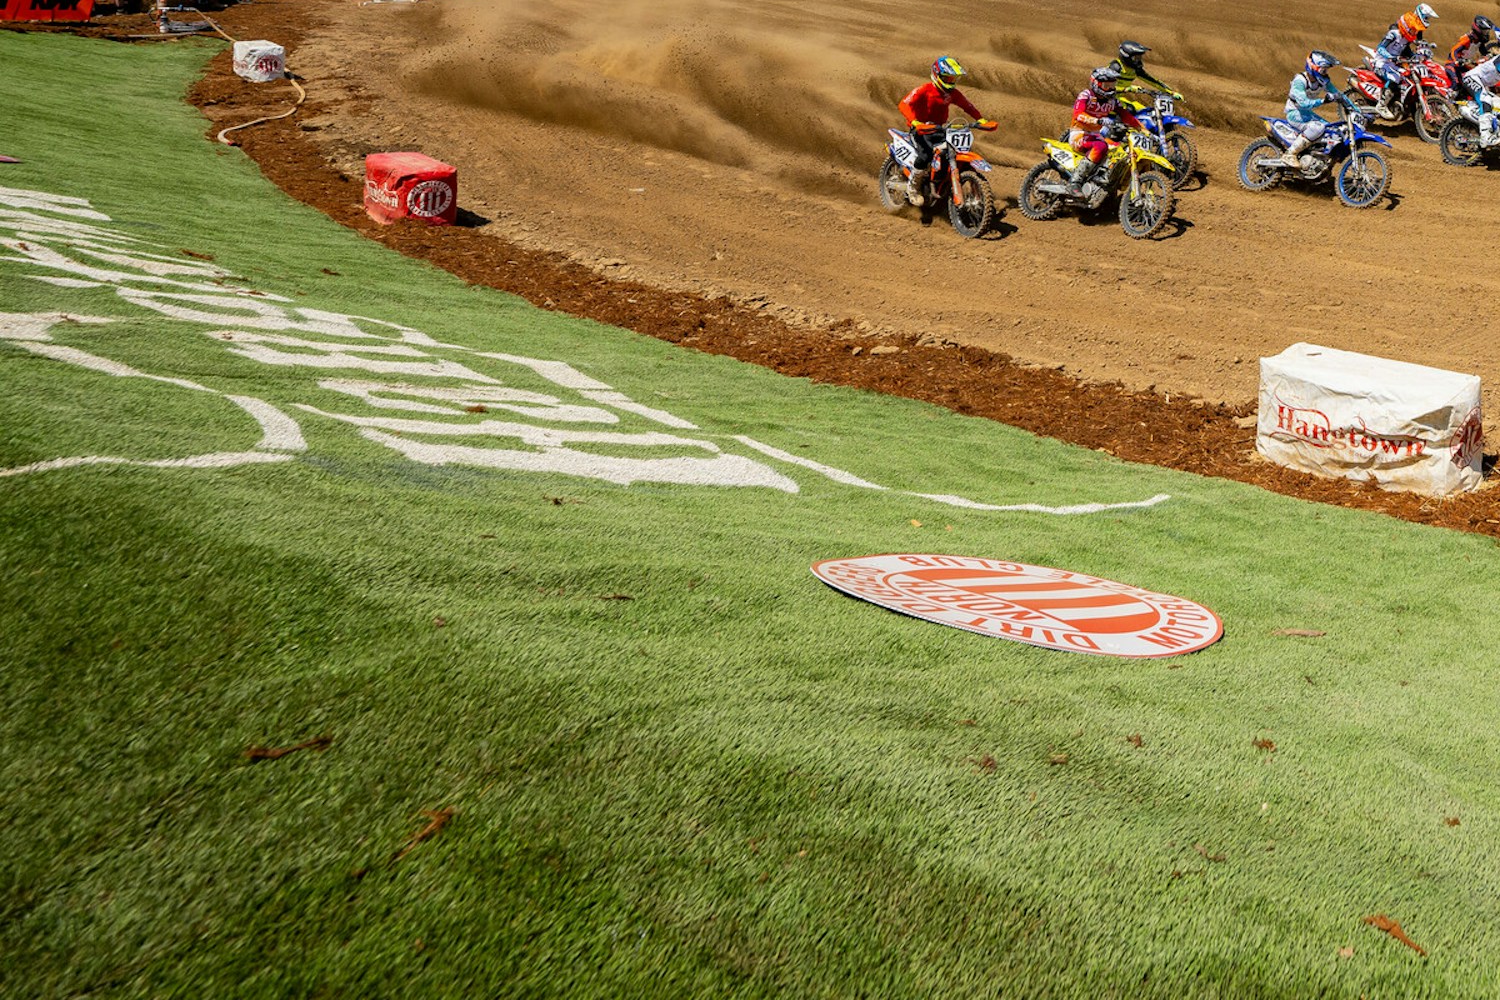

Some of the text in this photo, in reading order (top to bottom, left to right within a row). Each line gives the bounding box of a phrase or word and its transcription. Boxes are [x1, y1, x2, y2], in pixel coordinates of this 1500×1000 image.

[1364, 83, 1378, 95] 171
[1463, 76, 1482, 92] FXR
[1087, 100, 1116, 113] FXR
[952, 133, 972, 147] 671
[1133, 135, 1153, 151] 281
[895, 146, 913, 161] 671
[1054, 150, 1073, 164] 281
[895, 581, 1046, 620] NORTH
[898, 556, 1210, 650] MOTORCYCLE CLUB
[955, 617, 1102, 651] DIRT
